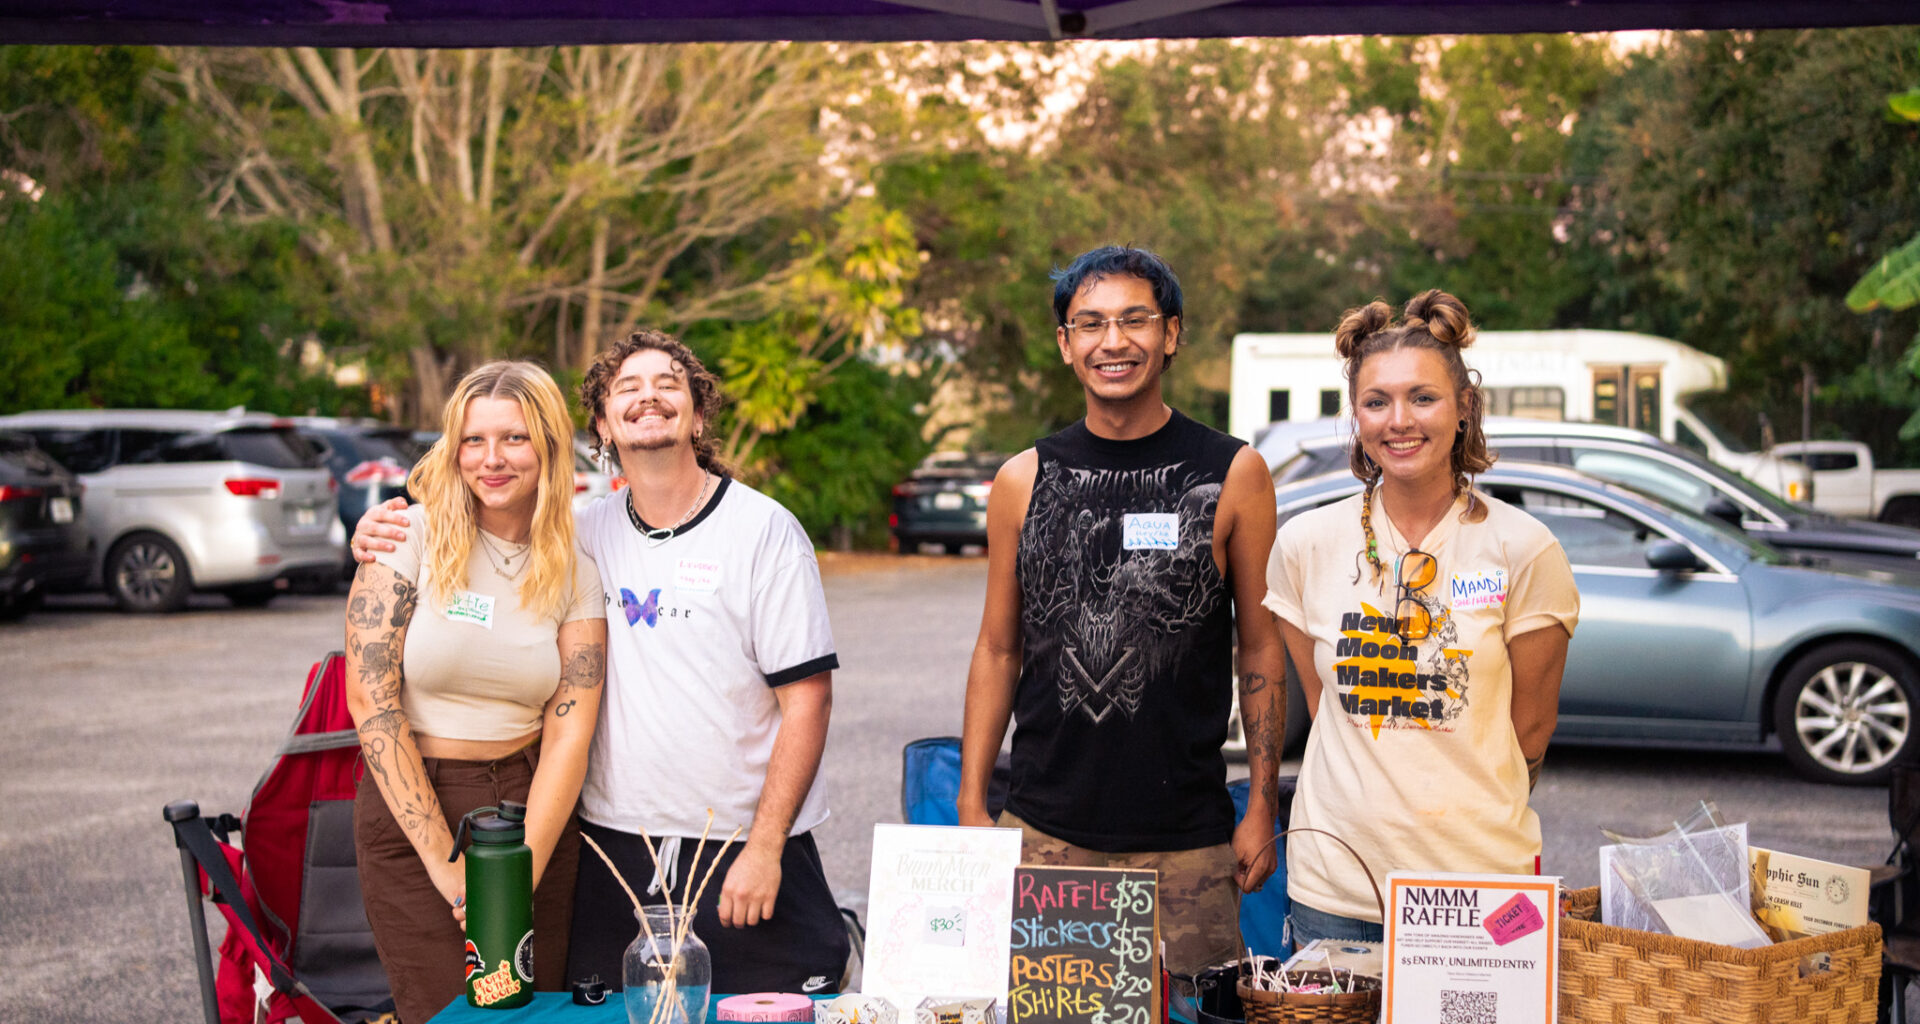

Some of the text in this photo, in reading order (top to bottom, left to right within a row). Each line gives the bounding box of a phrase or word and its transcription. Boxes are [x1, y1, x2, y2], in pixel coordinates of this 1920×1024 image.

[1340, 612, 1401, 634] New
[1336, 637, 1418, 661] Moon
[1336, 665, 1447, 691] Makers
[1338, 692, 1444, 719] Market
[912, 877, 974, 892] MERCH
[1797, 872, 1819, 888] Sun
[1018, 873, 1156, 922] RAFFLE $5
[1405, 887, 1478, 907] NMMM
[930, 918, 955, 932] $30
[1402, 907, 1480, 928] RAFFLE
[1495, 904, 1523, 928] TICKET
[1110, 917, 1153, 970] $5
[1401, 956, 1412, 966] $5
[1449, 957, 1502, 968] UNLIMITED
[1503, 959, 1536, 970] ENTRY
[484, 970, 510, 986] OPEN
[807, 976, 826, 985] NIKE
[1012, 954, 1152, 1003] POSTERS $20
